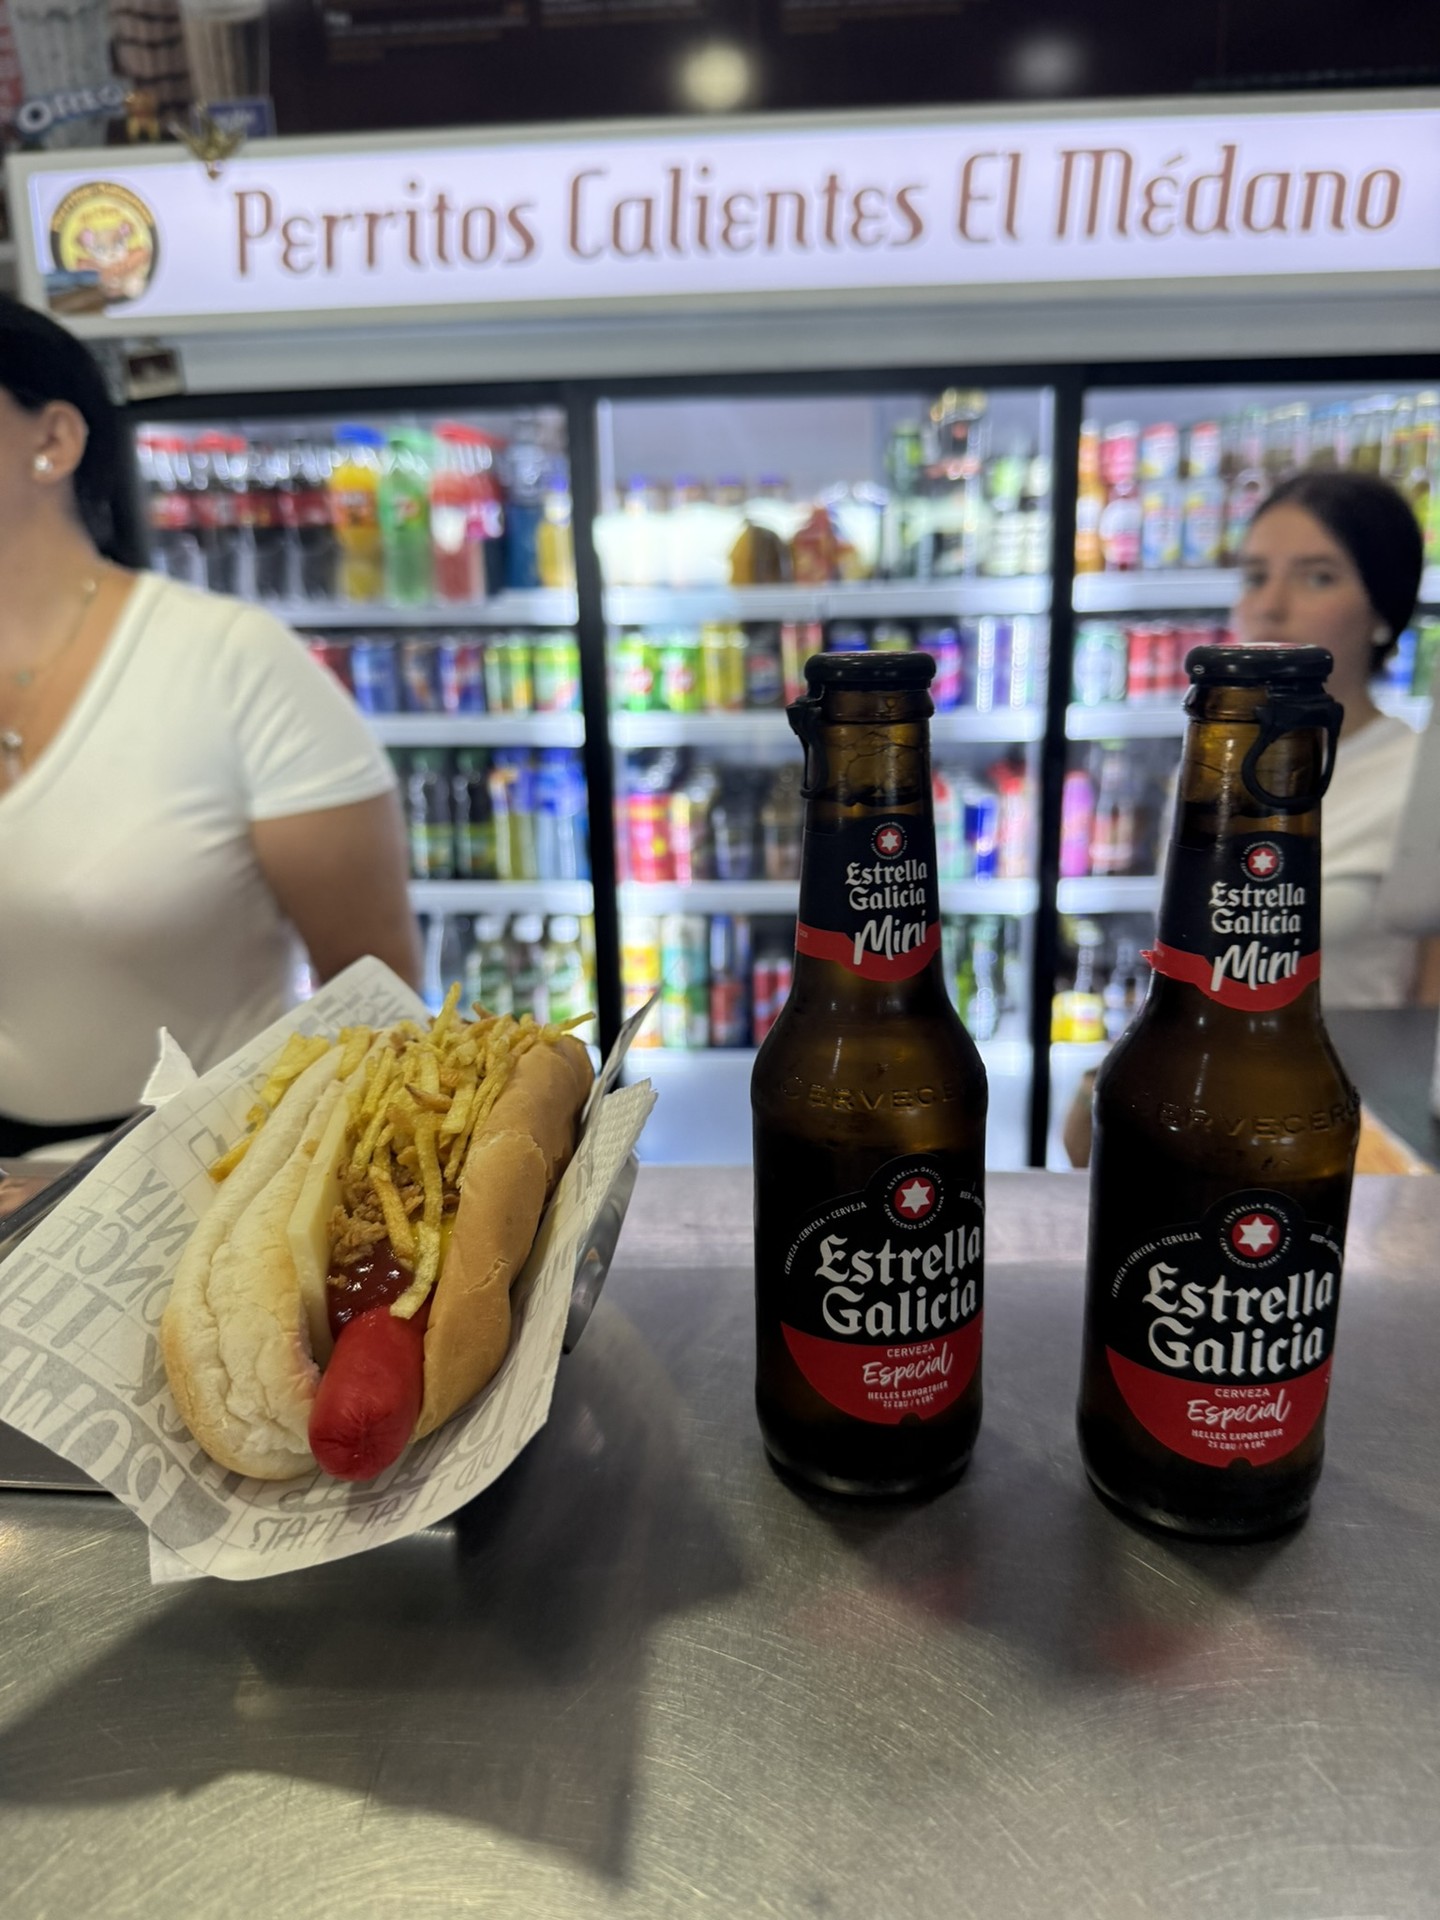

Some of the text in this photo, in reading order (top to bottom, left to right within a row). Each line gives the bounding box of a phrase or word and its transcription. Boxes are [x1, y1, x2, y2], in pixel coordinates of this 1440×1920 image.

[233, 181, 535, 277] Perritos
[568, 166, 924, 260] Calientes
[958, 151, 1022, 244] El
[1056, 144, 1402, 239] Médano
[845, 859, 927, 886] Estrella
[849, 883, 926, 911] Galicia
[1208, 881, 1306, 907] Estrella
[853, 909, 926, 966] Mini
[1211, 908, 1302, 935] Galicia
[1210, 938, 1300, 992] Mini
[784, 1201, 868, 1276] CERVEZA CERVEXA CERVEJA
[815, 1224, 982, 1286] Estrella
[1161, 1231, 1202, 1247] CERVEJA
[822, 1276, 977, 1337] Galicia
[1142, 1261, 1335, 1325] Estrella
[862, 1341, 954, 1390] Especial
[887, 1342, 936, 1359] CERVEZA
[1148, 1315, 1325, 1377] Galicia
[1186, 1388, 1292, 1430] Especial
[1214, 1387, 1271, 1399] CERVEZA
